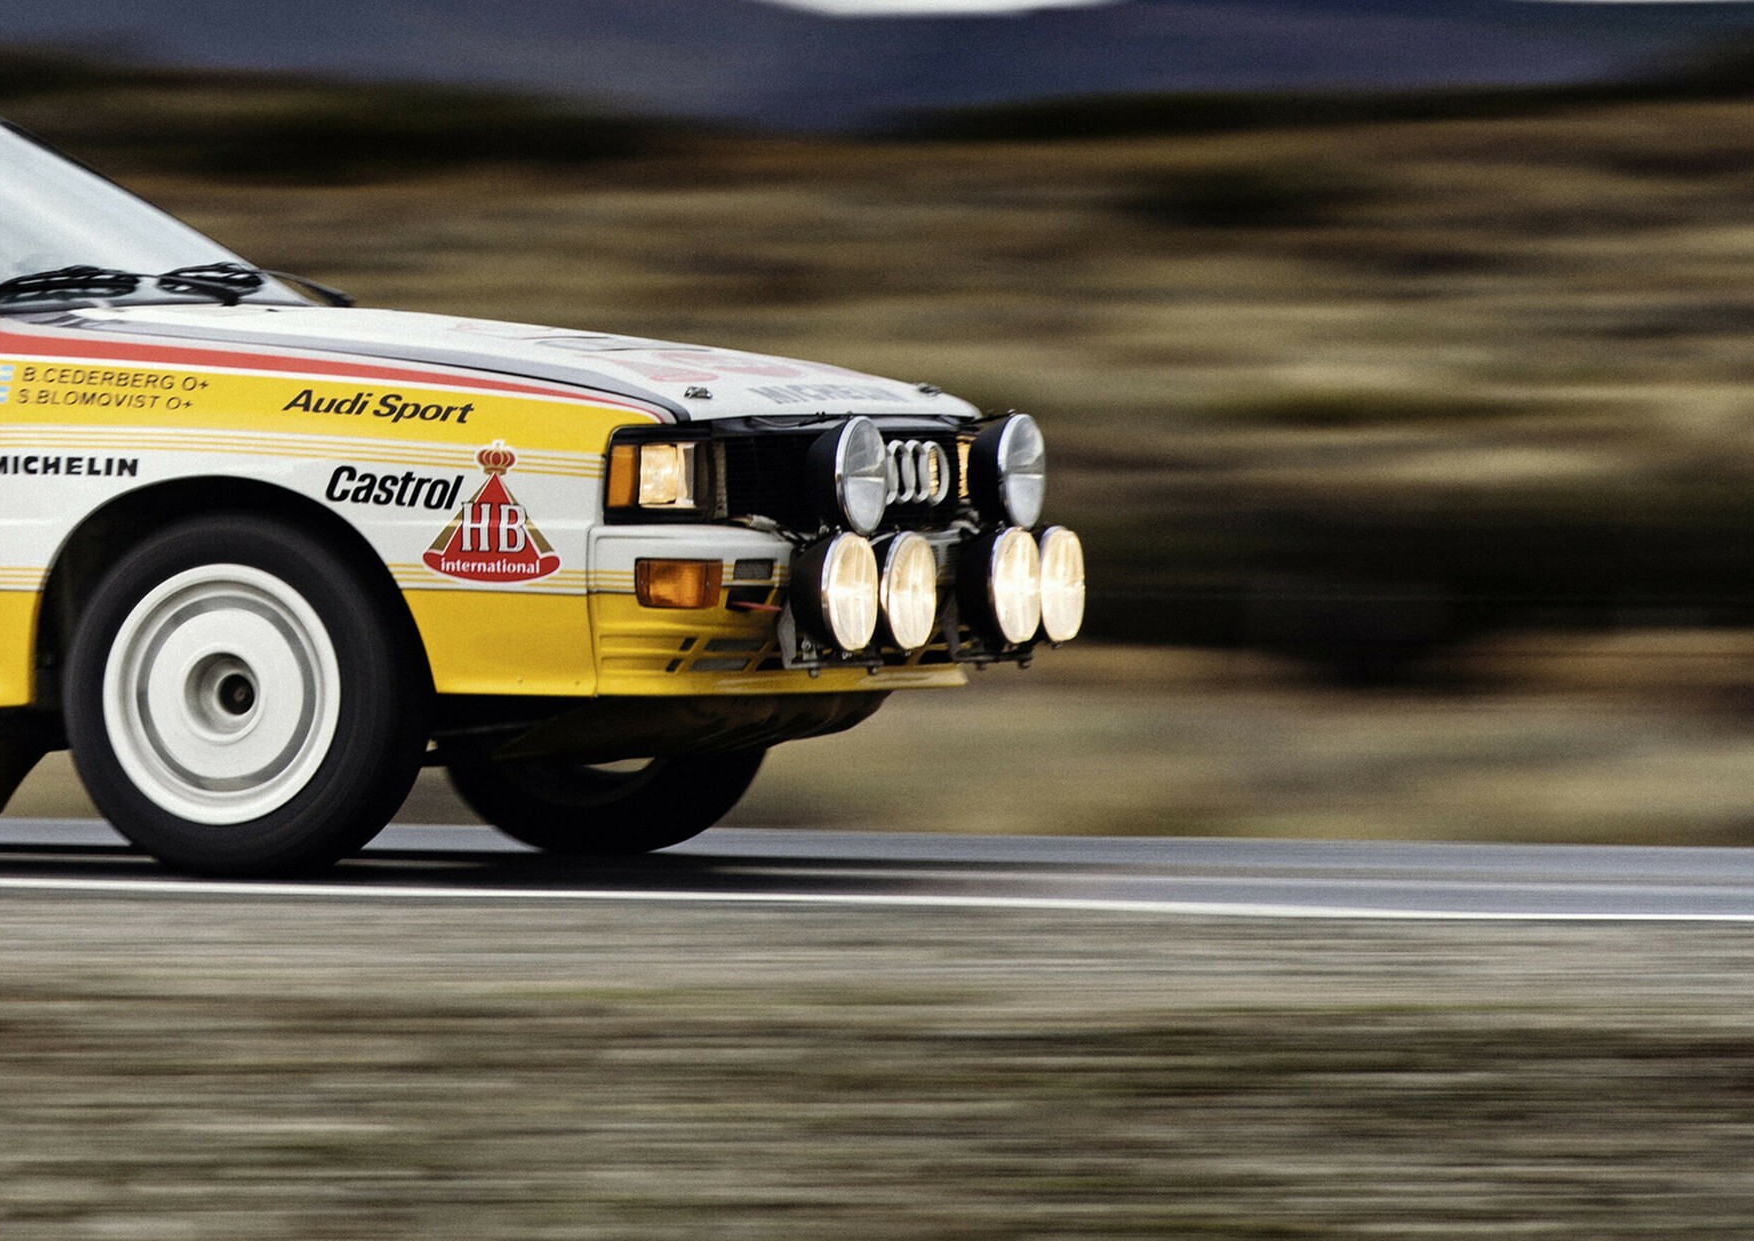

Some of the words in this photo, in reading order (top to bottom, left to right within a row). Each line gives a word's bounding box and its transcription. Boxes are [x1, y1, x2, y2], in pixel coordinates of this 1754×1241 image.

[282, 389, 373, 416] Audi
[372, 393, 475, 424] Sport
[325, 465, 465, 511] Castrol
[459, 500, 529, 554] HB
[440, 556, 541, 575] international
